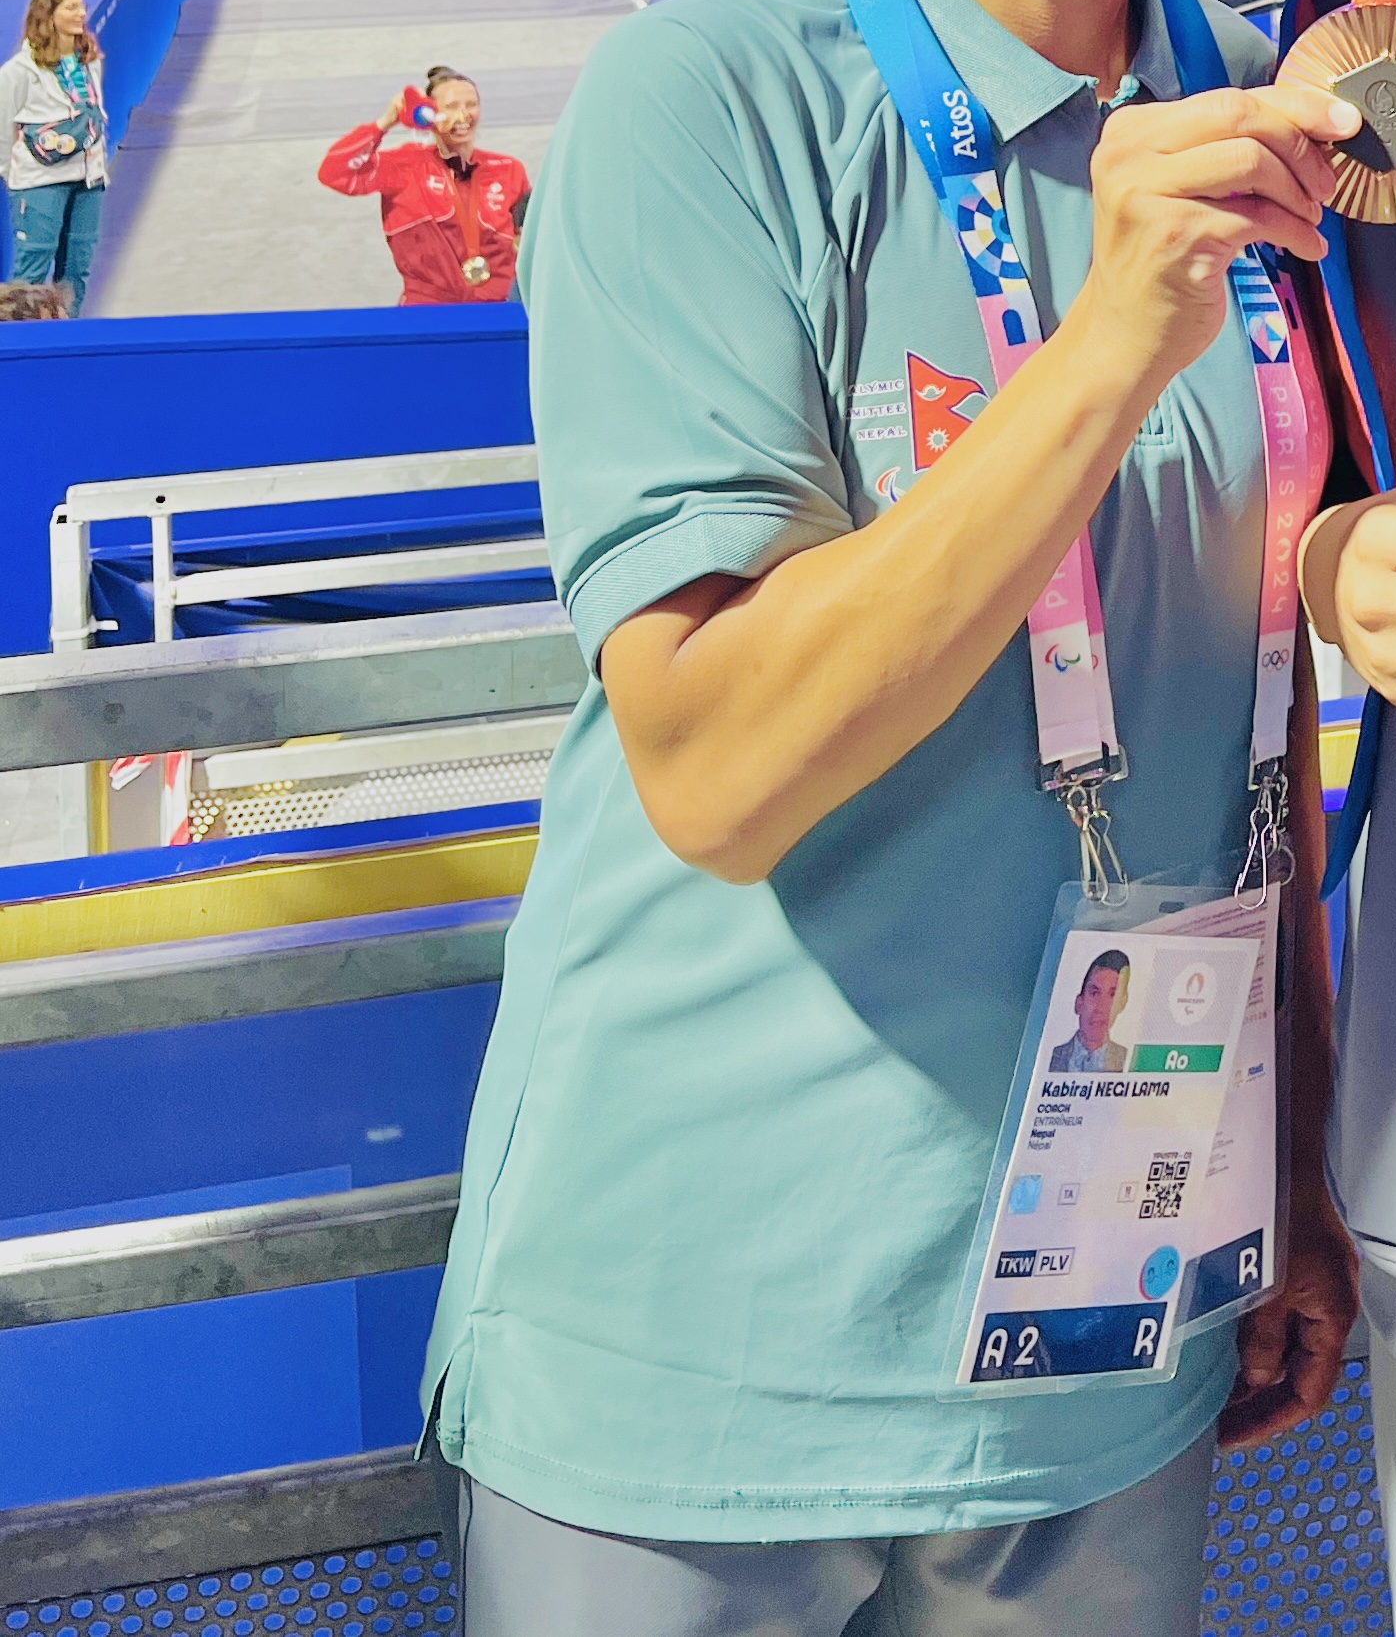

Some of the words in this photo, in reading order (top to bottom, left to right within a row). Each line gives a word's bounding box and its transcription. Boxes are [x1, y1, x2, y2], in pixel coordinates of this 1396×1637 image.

[942, 89, 978, 159] Atos
[848, 402, 906, 419] MITTEE
[856, 426, 907, 441] NEPAL
[1270, 386, 1296, 497] PARIS
[1271, 512, 1293, 613] 2024
[1041, 1080, 1094, 1100] Kabiraj
[1095, 1081, 1130, 1097] NEGI
[1131, 1081, 1170, 1098] LAMA
[1037, 1103, 1071, 1114] COACH
[1030, 1128, 1056, 1140] Nepal
[1000, 1256, 1035, 1274] TKW
[1039, 1254, 1069, 1272] PLV
[1238, 1246, 1259, 1286] R
[981, 1328, 1009, 1369] A
[1013, 1325, 1040, 1366] 2
[1133, 1317, 1159, 1357] R
